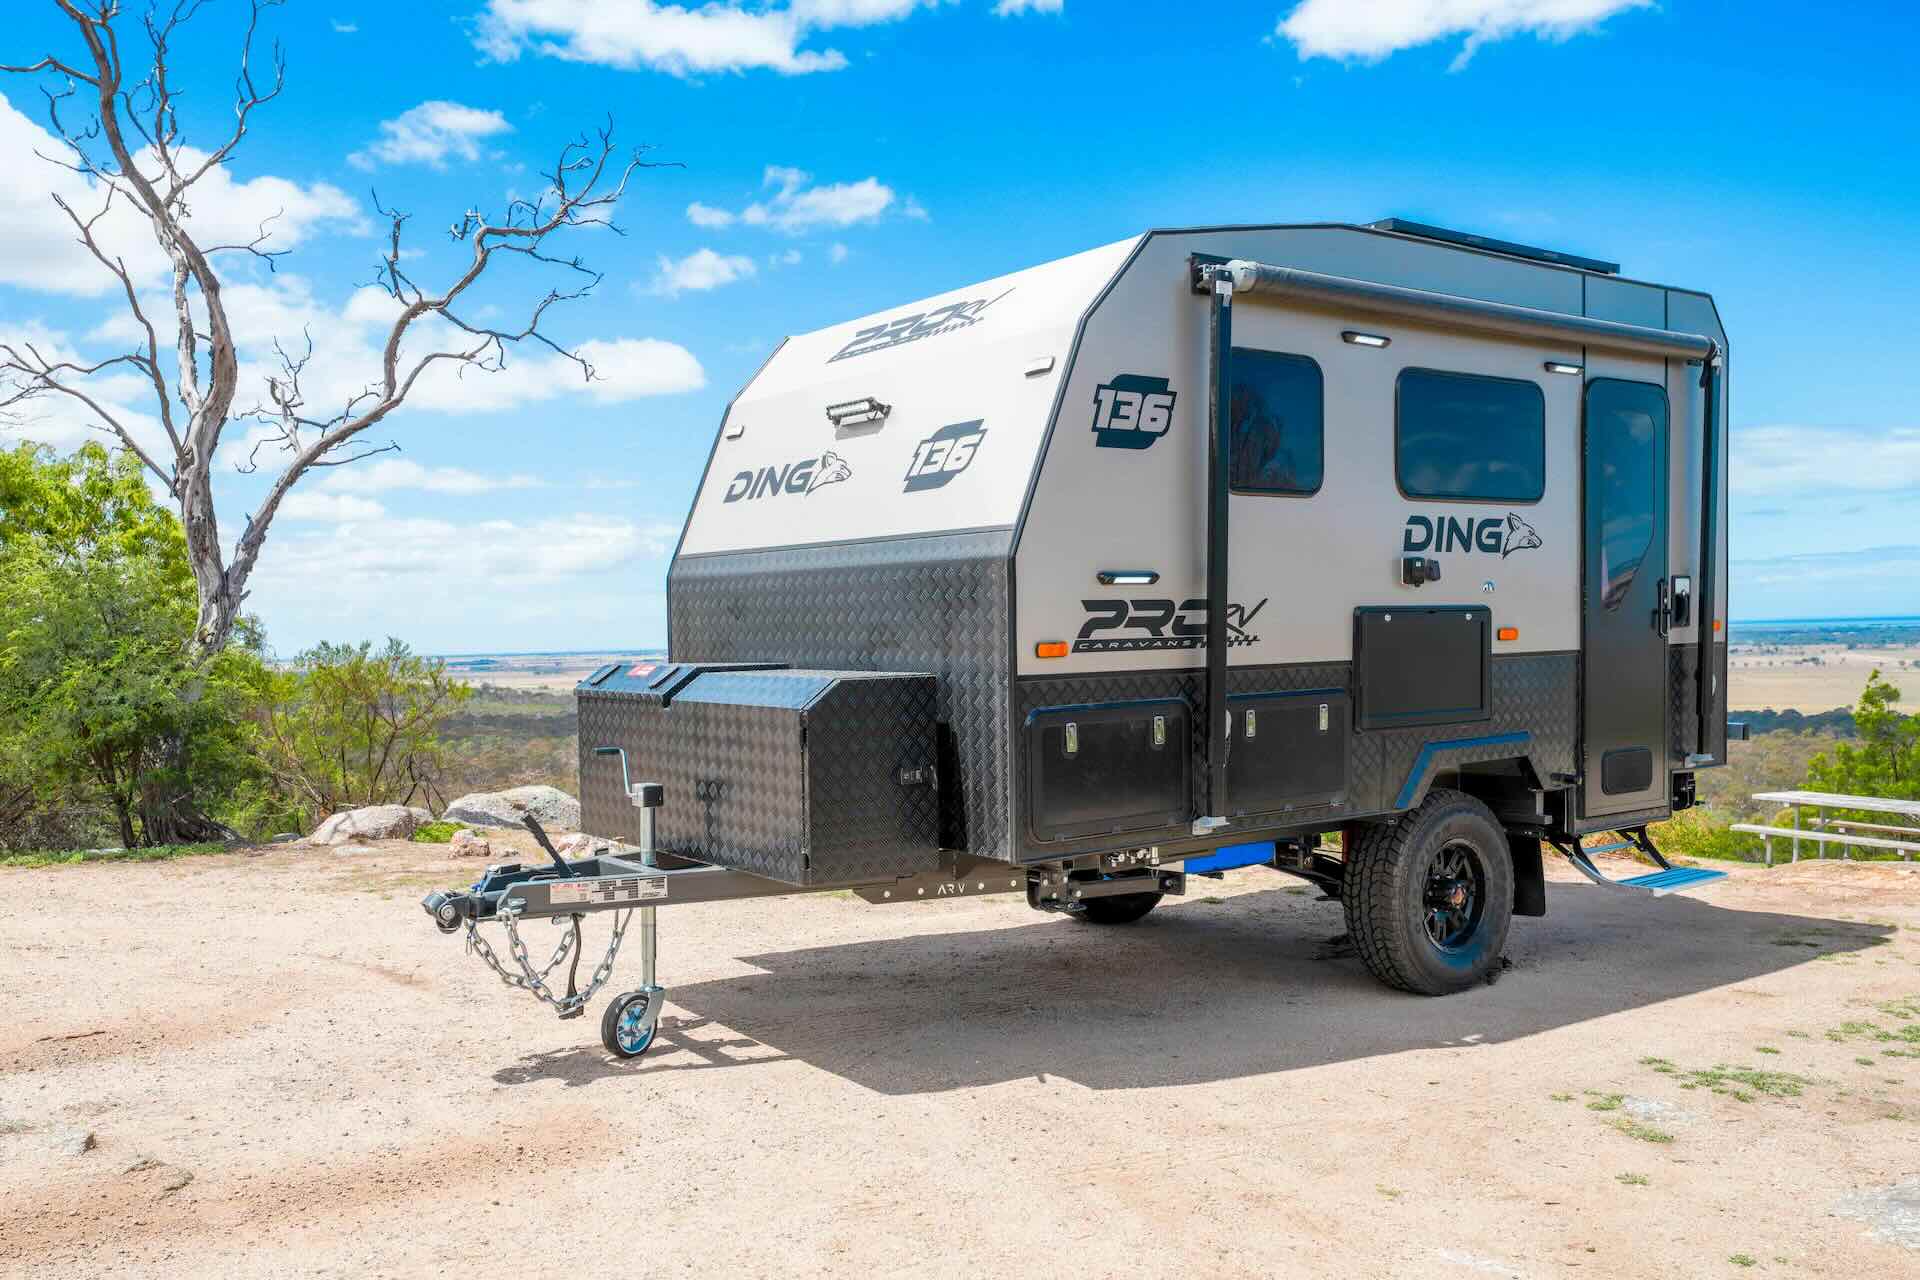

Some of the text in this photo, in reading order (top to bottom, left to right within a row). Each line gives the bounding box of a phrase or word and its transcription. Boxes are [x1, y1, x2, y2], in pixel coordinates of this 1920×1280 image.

[1094, 386, 1175, 436] 136
[905, 432, 985, 479] 136
[1078, 639, 1192, 650] CARAVANS
[937, 883, 966, 895] ARV
